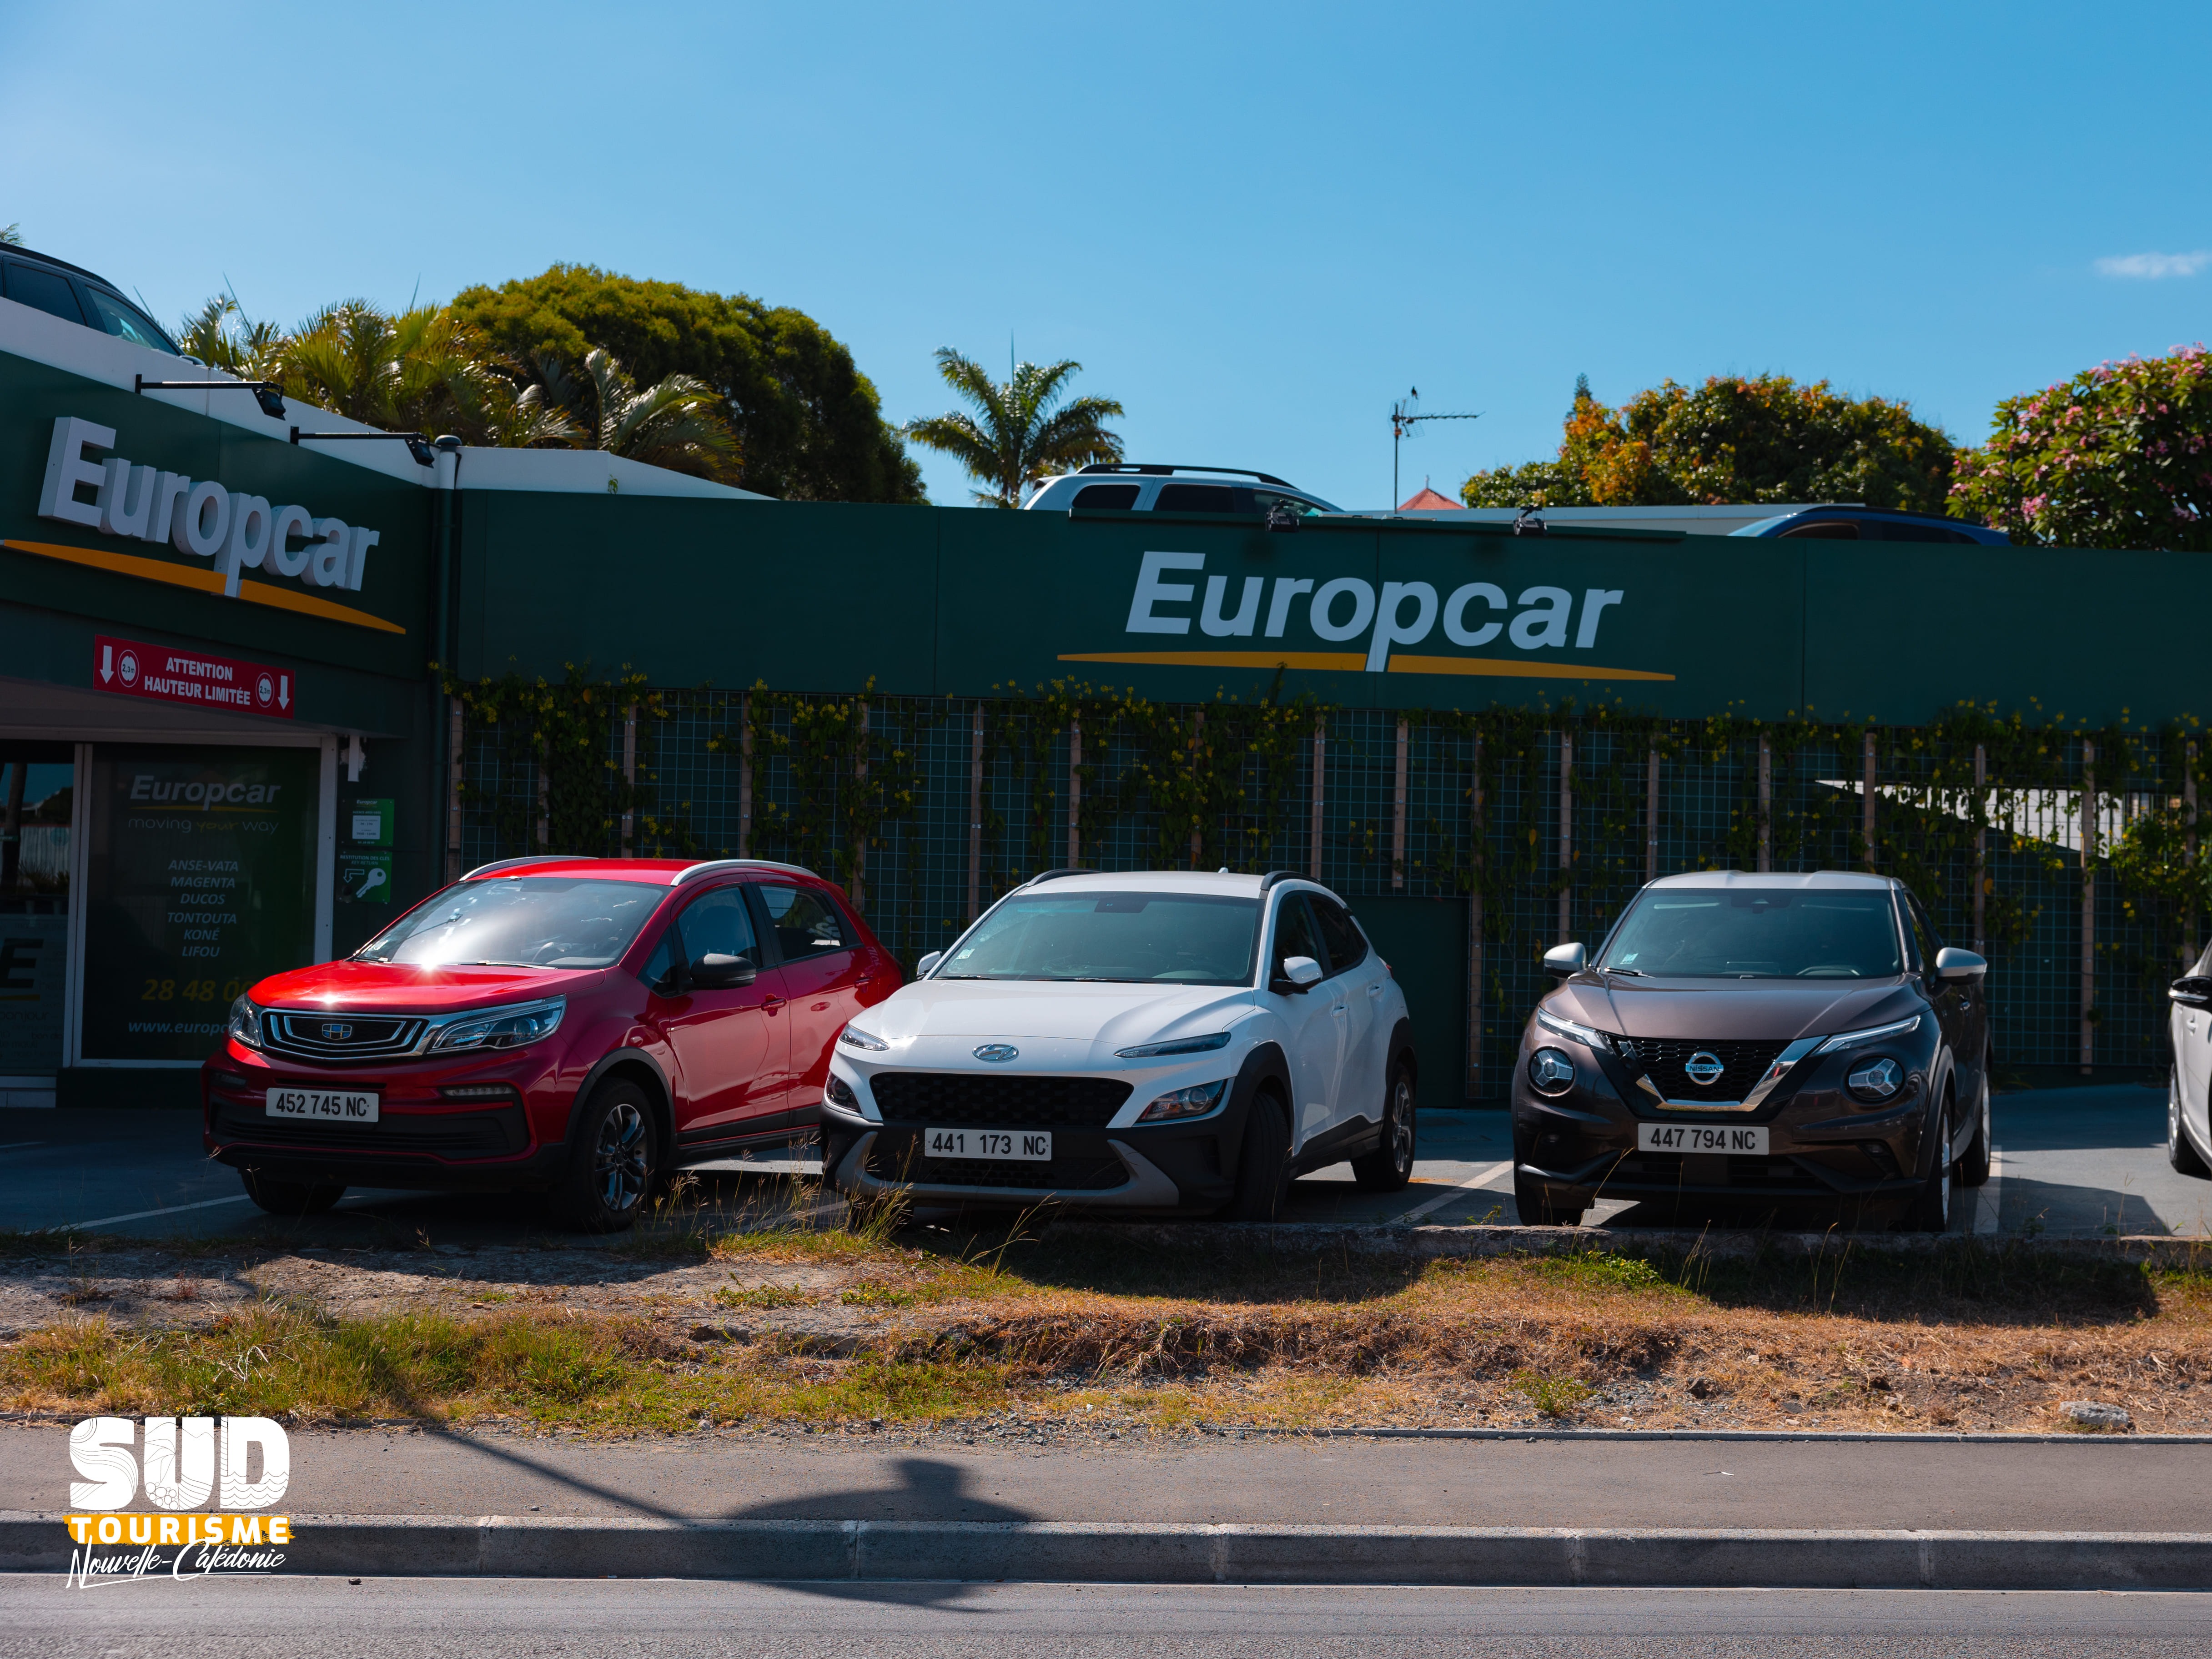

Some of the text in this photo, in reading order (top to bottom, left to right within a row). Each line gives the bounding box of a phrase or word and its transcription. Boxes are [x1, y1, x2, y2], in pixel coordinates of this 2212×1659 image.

[38, 416, 380, 598] Europcar
[1126, 551, 1624, 672] Europcar
[166, 657, 232, 681] ATTENTION
[145, 676, 250, 705] HAUTEUR LIMITÉE
[130, 775, 281, 811] Europcar
[128, 817, 279, 835] moving your way
[168, 860, 239, 872] ANSE-VATA
[171, 876, 236, 888] MAGENTA
[180, 893, 226, 905] DUCOS
[167, 912, 237, 925] TONTOUTA
[183, 926, 220, 940] KONÉ
[182, 946, 221, 957] LIFOU
[141, 979, 176, 1000] 28
[182, 979, 216, 1002] 48
[276, 1093, 367, 1116] 452 745 NC
[932, 1133, 1046, 1155] 441 173 NC
[1650, 1128, 1755, 1150] 447 794 NC
